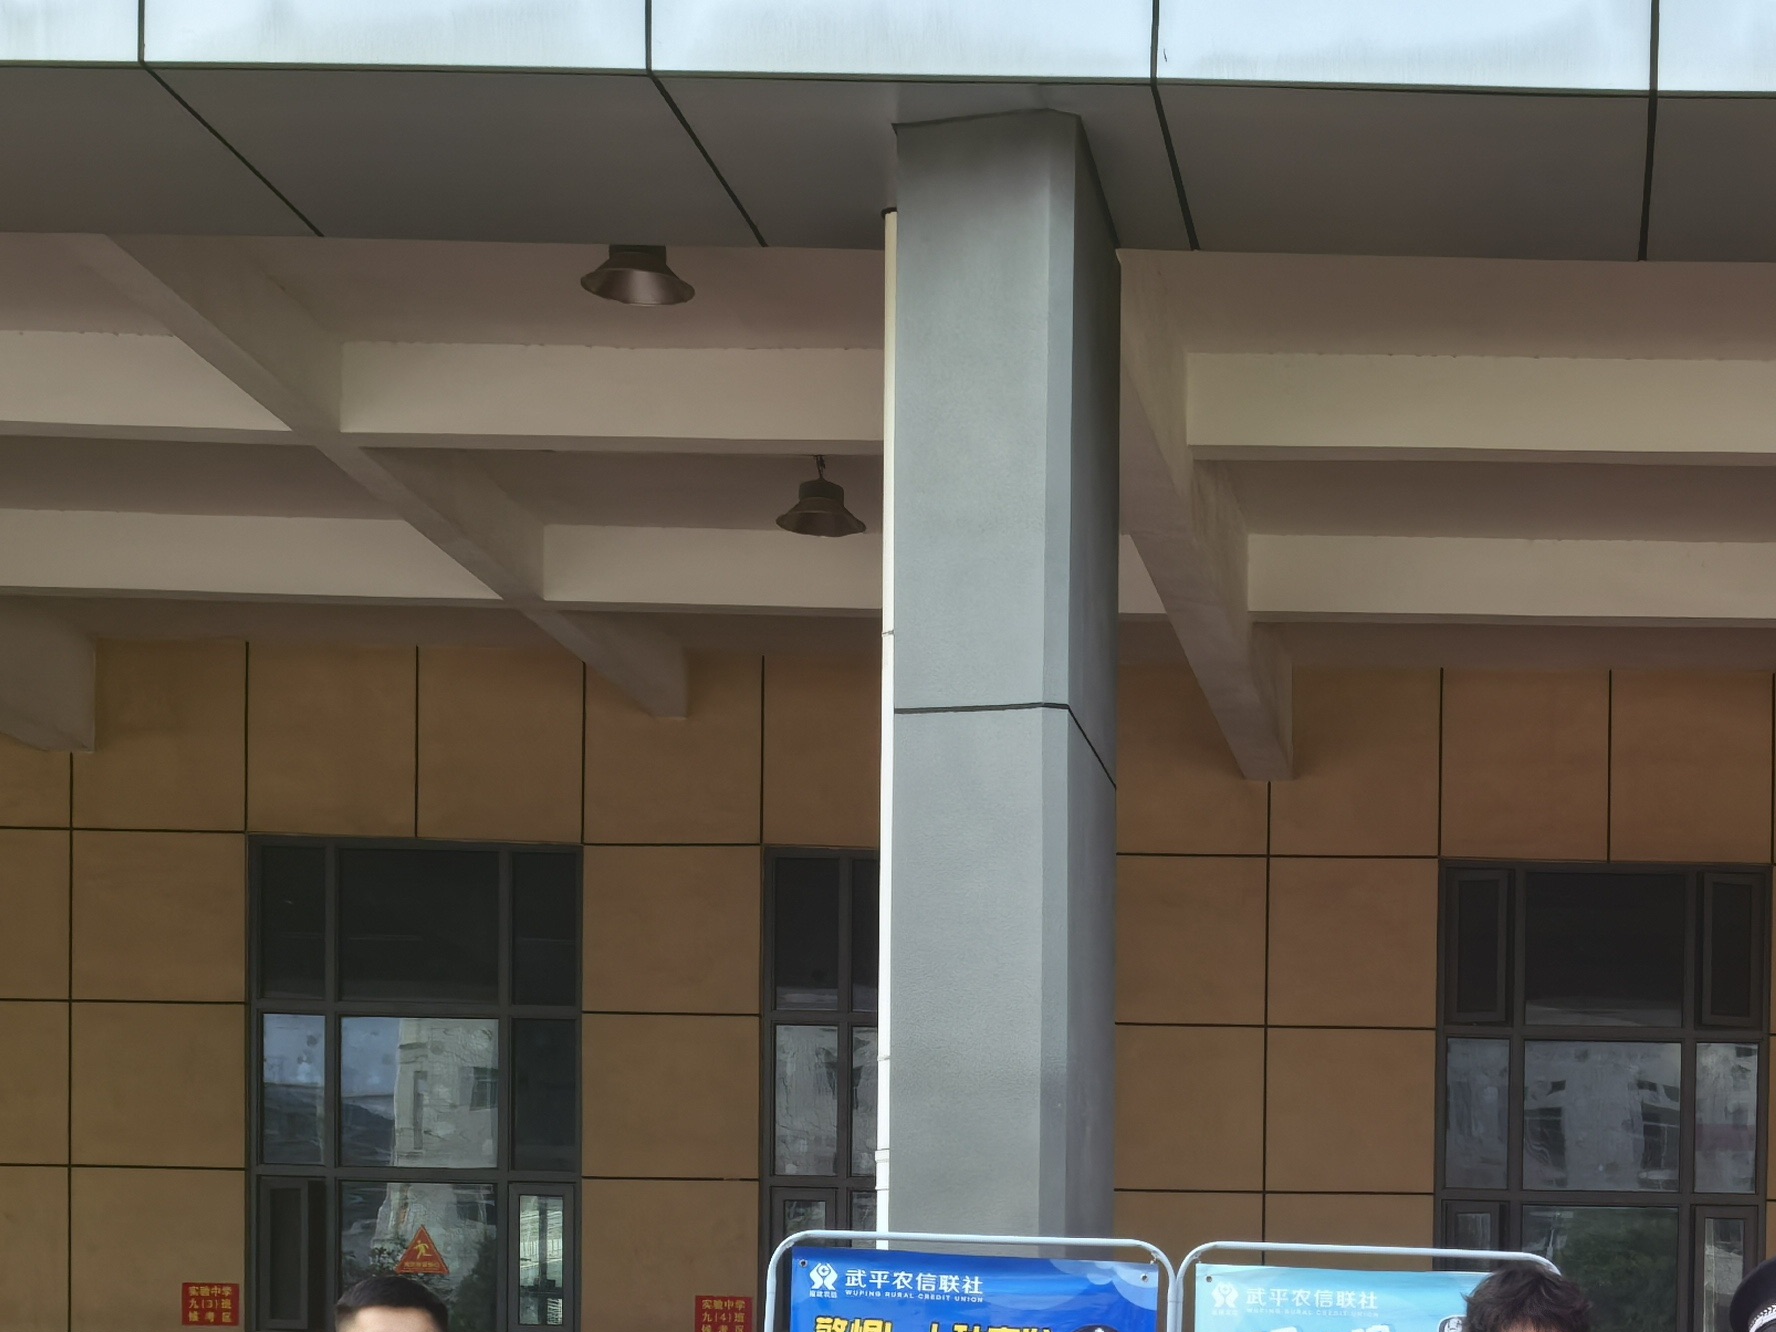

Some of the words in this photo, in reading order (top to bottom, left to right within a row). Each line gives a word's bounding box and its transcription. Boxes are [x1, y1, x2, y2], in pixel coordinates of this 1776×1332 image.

[845, 1269, 983, 1294] 武平农信联社
[845, 1289, 881, 1297] WUPING
[885, 1291, 914, 1299] RURAL
[918, 1293, 950, 1301] CREDIT
[1246, 1288, 1378, 1309] 武平农信联社
